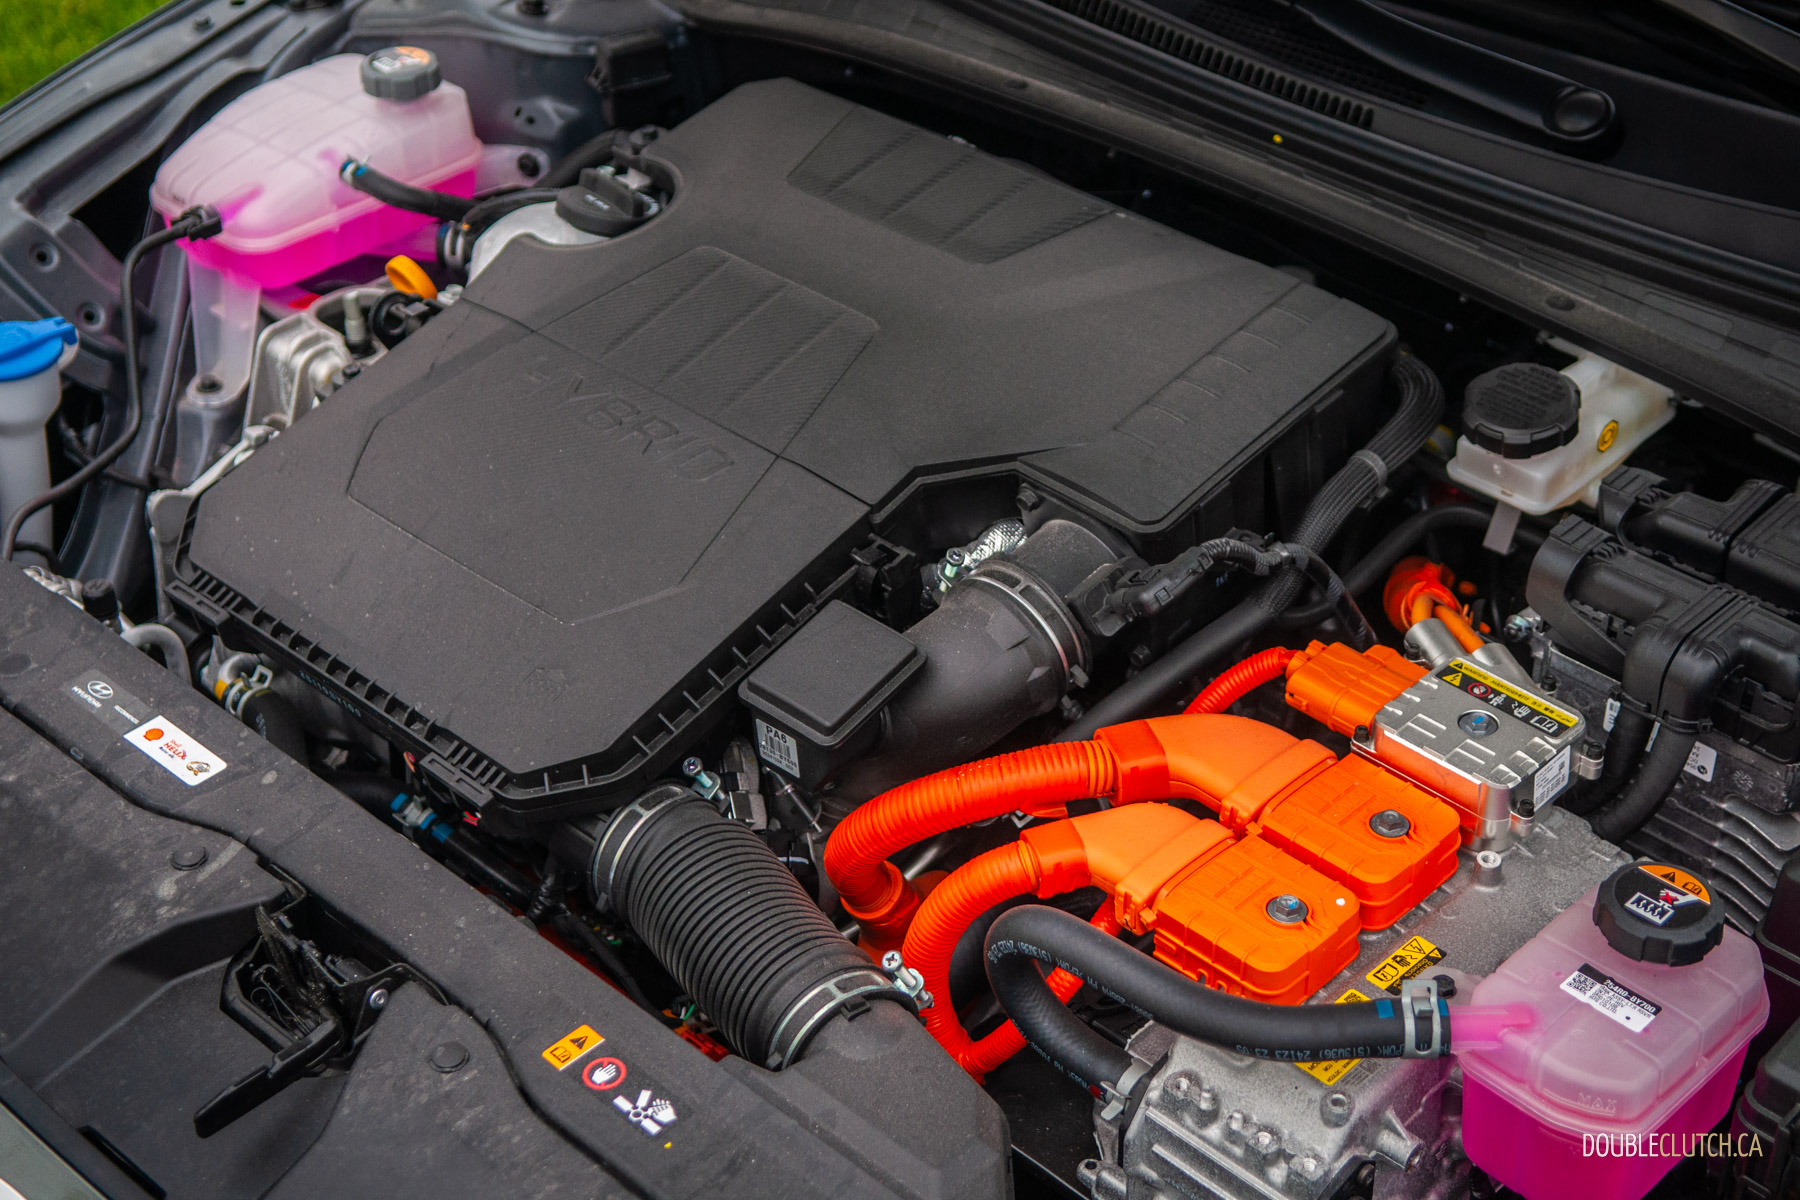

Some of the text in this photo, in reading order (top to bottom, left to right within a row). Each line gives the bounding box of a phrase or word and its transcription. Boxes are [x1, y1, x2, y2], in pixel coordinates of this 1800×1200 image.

[71, 686, 102, 708] HYUNDAI
[163, 742, 188, 760] HELIX
[1275, 1050, 1311, 1060] 24123
[1578, 1092, 1617, 1114] MAX
